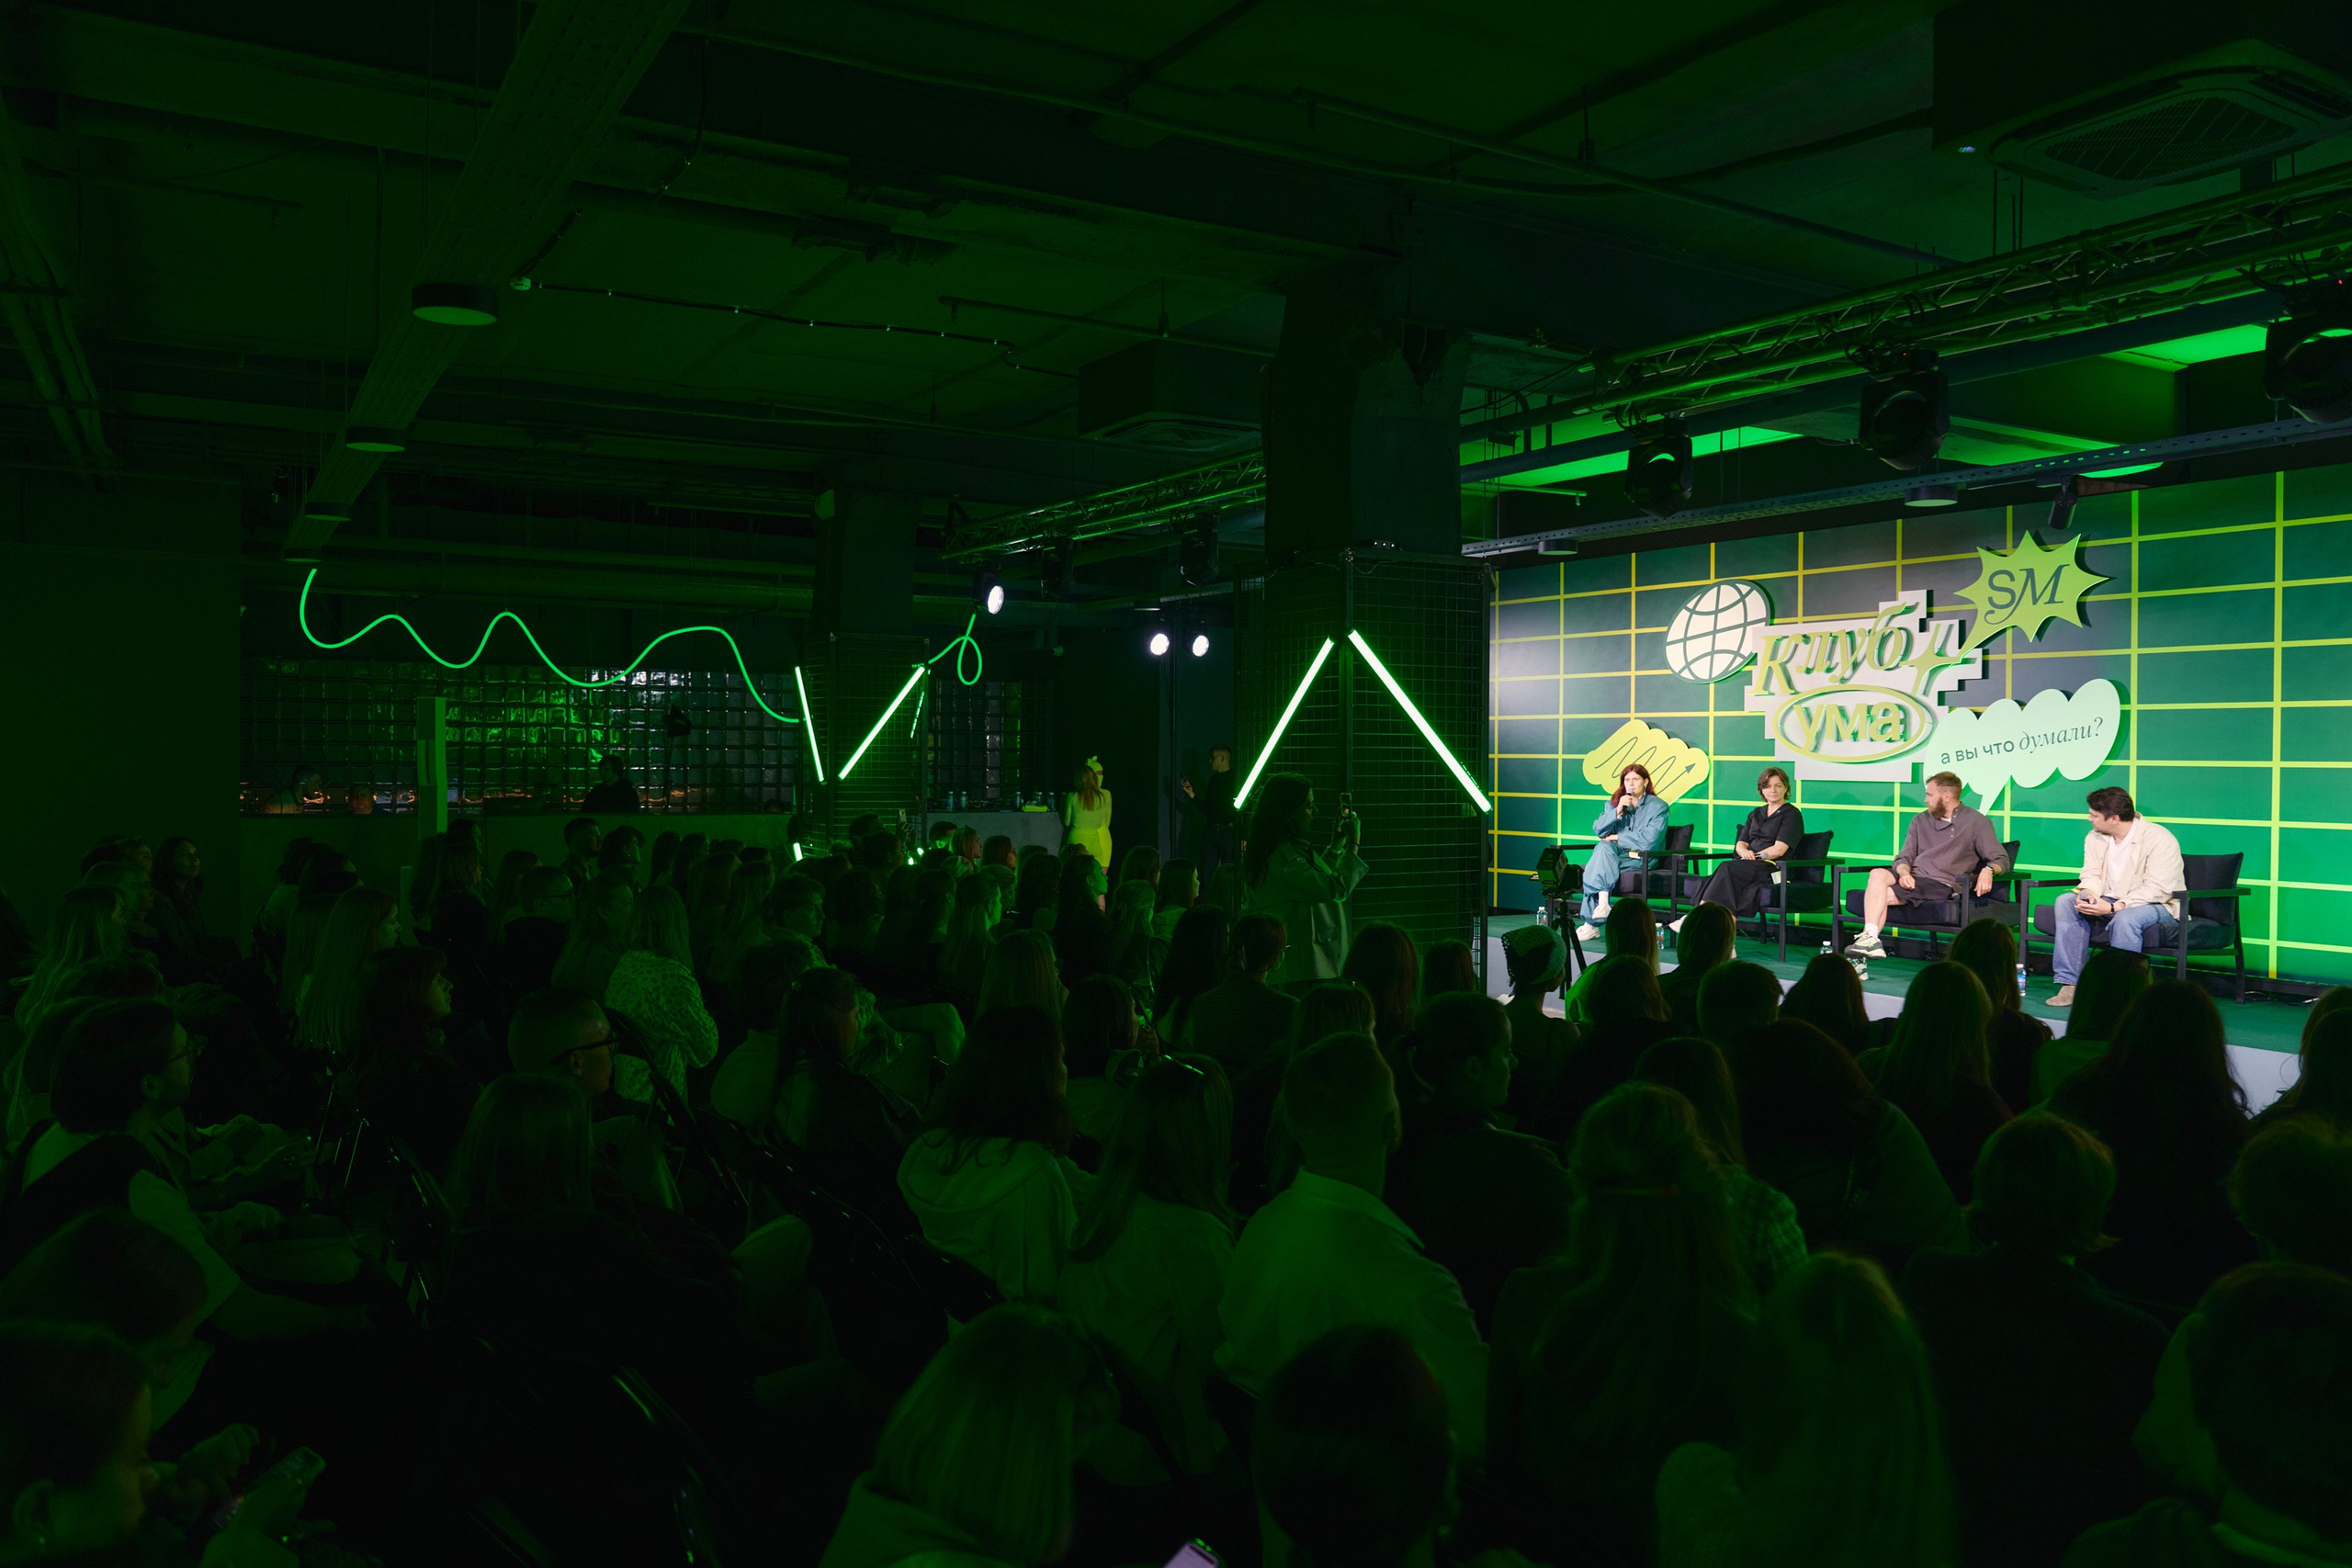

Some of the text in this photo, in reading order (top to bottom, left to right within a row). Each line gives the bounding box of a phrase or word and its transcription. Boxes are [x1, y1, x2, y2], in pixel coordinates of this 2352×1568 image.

[1984, 564, 2070, 625] SM
[1748, 602, 1908, 695] Клуб
[1793, 701, 1901, 753] ума
[1940, 716, 2104, 764] а вы что думали?
